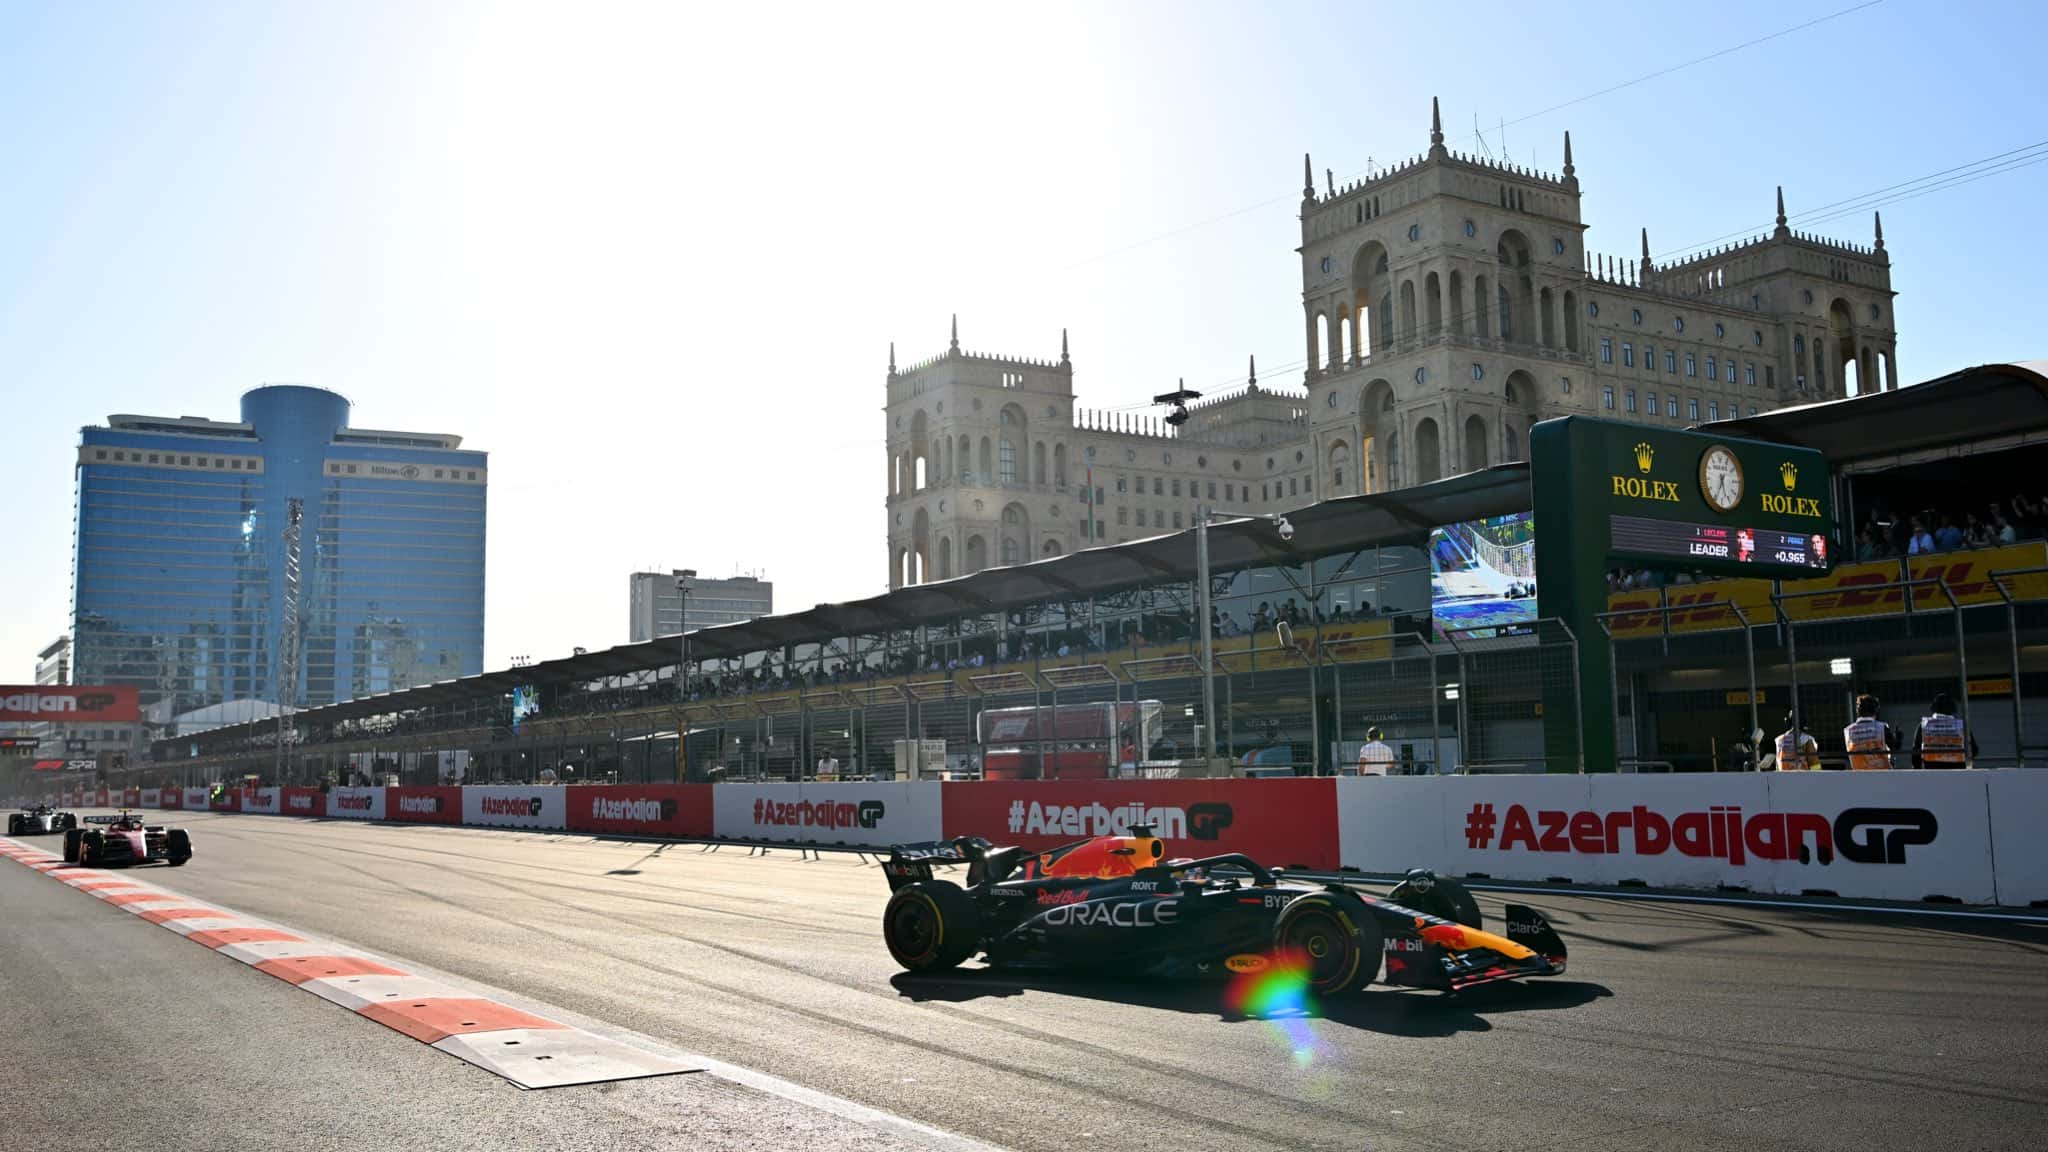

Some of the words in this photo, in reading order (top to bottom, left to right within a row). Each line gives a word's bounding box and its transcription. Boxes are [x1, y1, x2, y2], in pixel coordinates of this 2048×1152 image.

[1612, 476, 1680, 502] ROLEX
[1761, 494, 1821, 517] ROLEX
[1690, 543, 1728, 557] LEADER
[1774, 551, 1805, 563] +0.965
[0, 693, 115, 714] aijanGP
[753, 799, 884, 830] #AzerbaijanGP
[1008, 800, 1232, 840] #AzerbaijanGP
[1464, 803, 1938, 866] #AzerbaijanGP
[886, 863, 919, 876] Mobil
[990, 888, 1024, 897] HONDA
[1037, 887, 1062, 905] Red
[1060, 888, 1089, 904] Bull
[1044, 900, 1179, 928] ORACLE
[1507, 920, 1540, 934] Claro
[1384, 937, 1423, 952] Mobil
